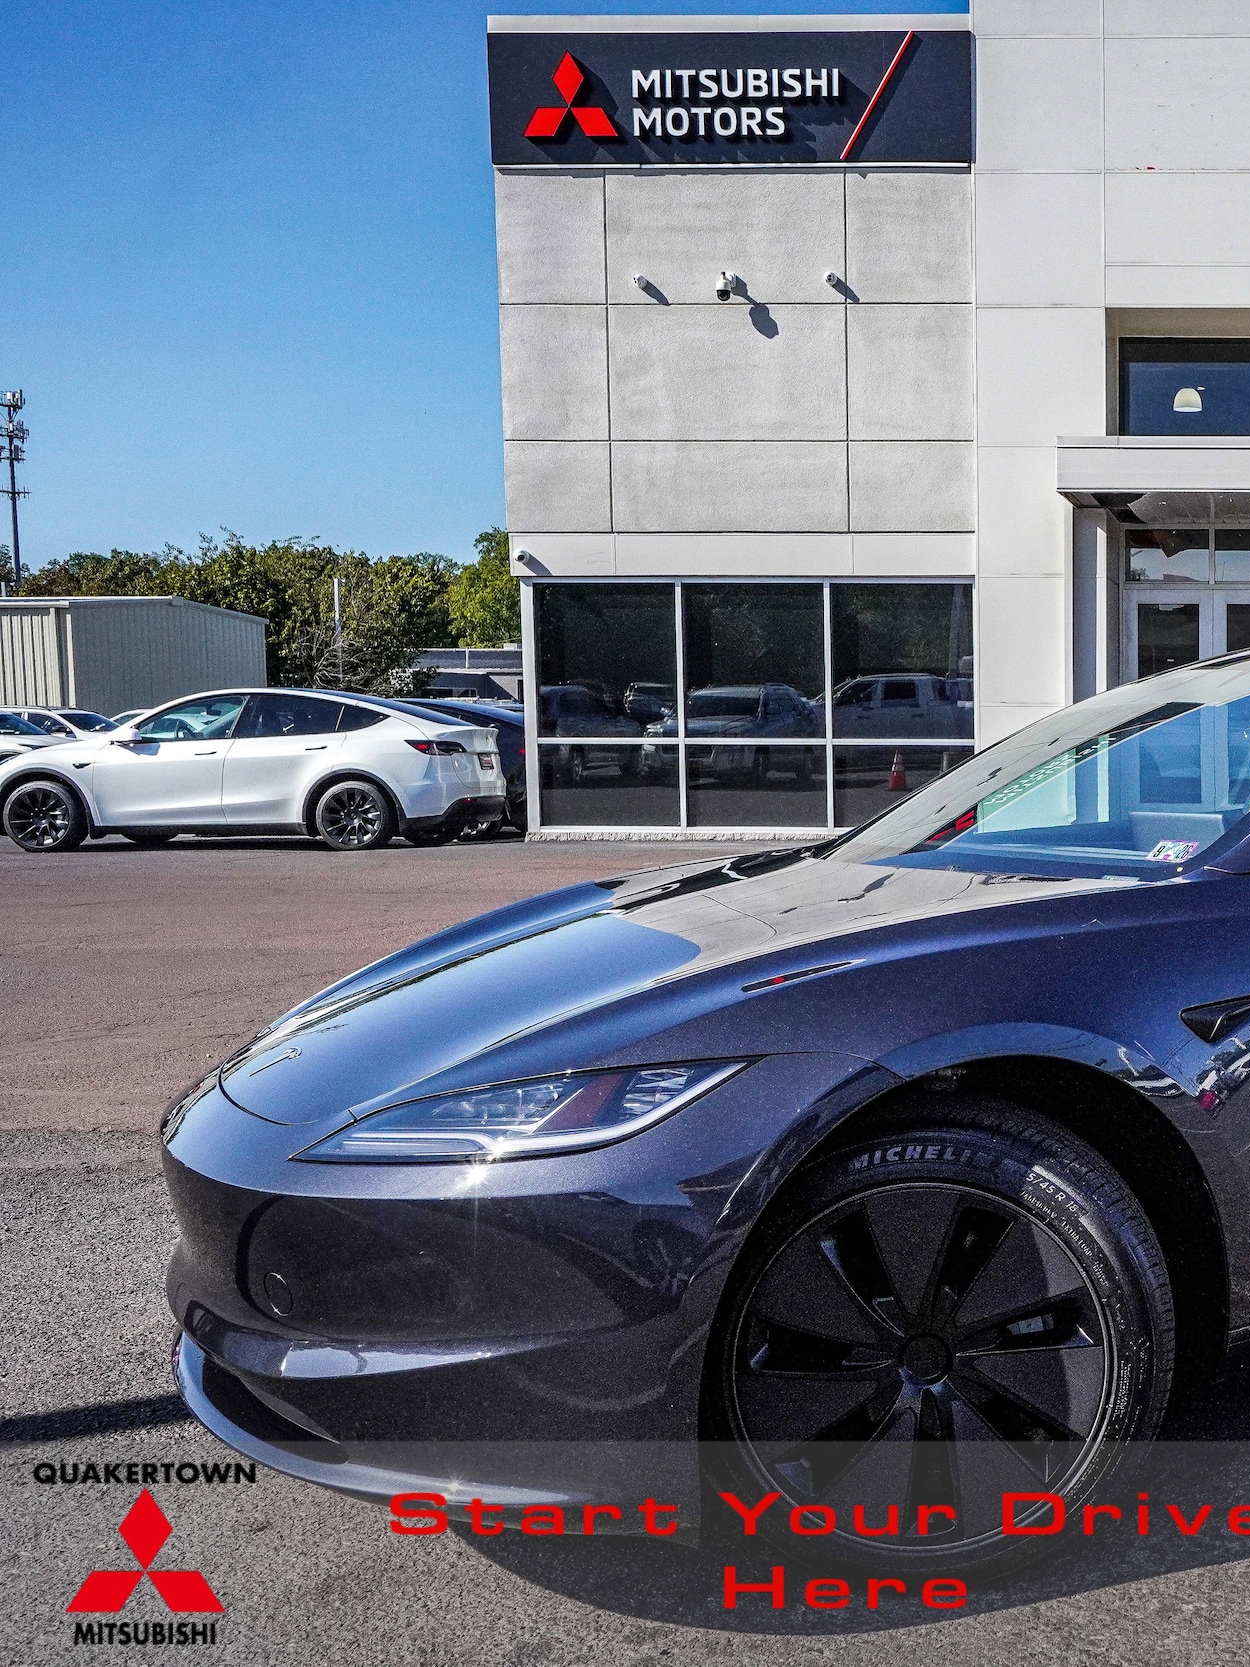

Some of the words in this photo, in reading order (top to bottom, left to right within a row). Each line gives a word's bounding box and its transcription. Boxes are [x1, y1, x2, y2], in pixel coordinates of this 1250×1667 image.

[631, 68, 840, 99] MITSUBISHI
[633, 106, 786, 137] MOTORS
[1153, 845, 1166, 858] 9
